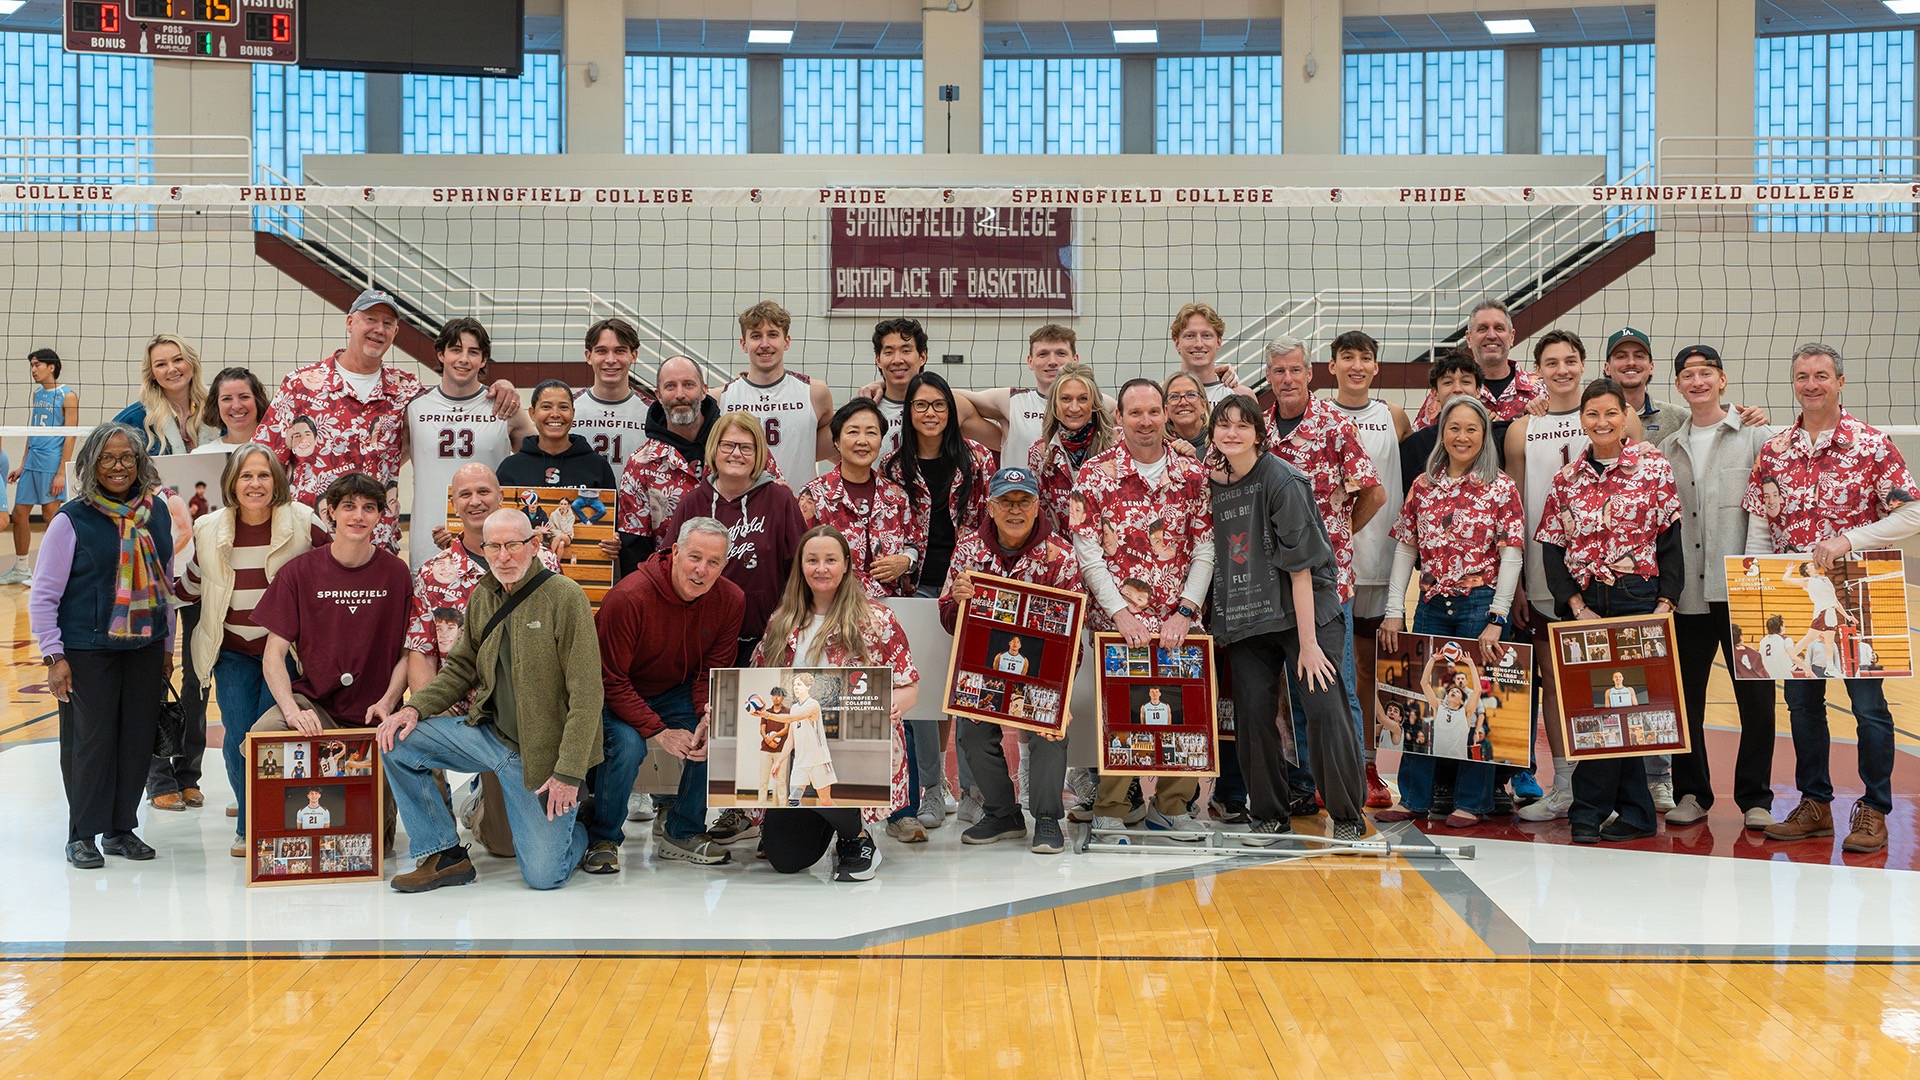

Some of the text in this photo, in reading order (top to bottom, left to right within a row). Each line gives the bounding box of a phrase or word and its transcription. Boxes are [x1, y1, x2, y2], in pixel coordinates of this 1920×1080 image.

[101, 3, 119, 32] 0
[162, 25, 183, 34] POSS
[272, 14, 290, 42] 0
[91, 37, 126, 49] BONUS
[154, 34, 191, 45] PERIOD
[205, 32, 212, 54] 1
[240, 45, 273, 57] BONUS
[15, 186, 113, 200] COLLEGE
[240, 187, 306, 201] PRIDE
[432, 188, 693, 203] SPRINGFIELD COLLEGE
[819, 189, 886, 204] PRIDE
[1012, 189, 1273, 203] SPRINGFIELD COLLEGE
[1399, 188, 1466, 202] PRIDE
[1592, 185, 1855, 201] SPRINGFIELD COLLEGE
[845, 206, 1058, 238] SPRINGFIELD COLLEGE
[836, 267, 1067, 300] BIRTHPLACE OF BASKETBALL
[296, 393, 331, 408] SENIOR
[727, 402, 804, 412] SPRINGFIELD
[419, 414, 497, 423] SPRINGFIELD
[571, 419, 646, 431] SPRINGFIELD
[438, 427, 476, 459] 23
[592, 432, 623, 465] 21
[1281, 446, 1311, 461] SENIOR
[1827, 450, 1859, 465] SENIOR
[1762, 455, 1790, 468] SENIOR
[640, 468, 672, 481] SENIOR
[1612, 476, 1644, 488] SENIOR
[1463, 491, 1492, 509] SENIOR
[317, 590, 388, 599] SPRINGFIELD
[427, 585, 463, 598] SENIOR
[1486, 667, 1525, 675] SPRINGFIELD
[309, 816, 318, 824] 21
